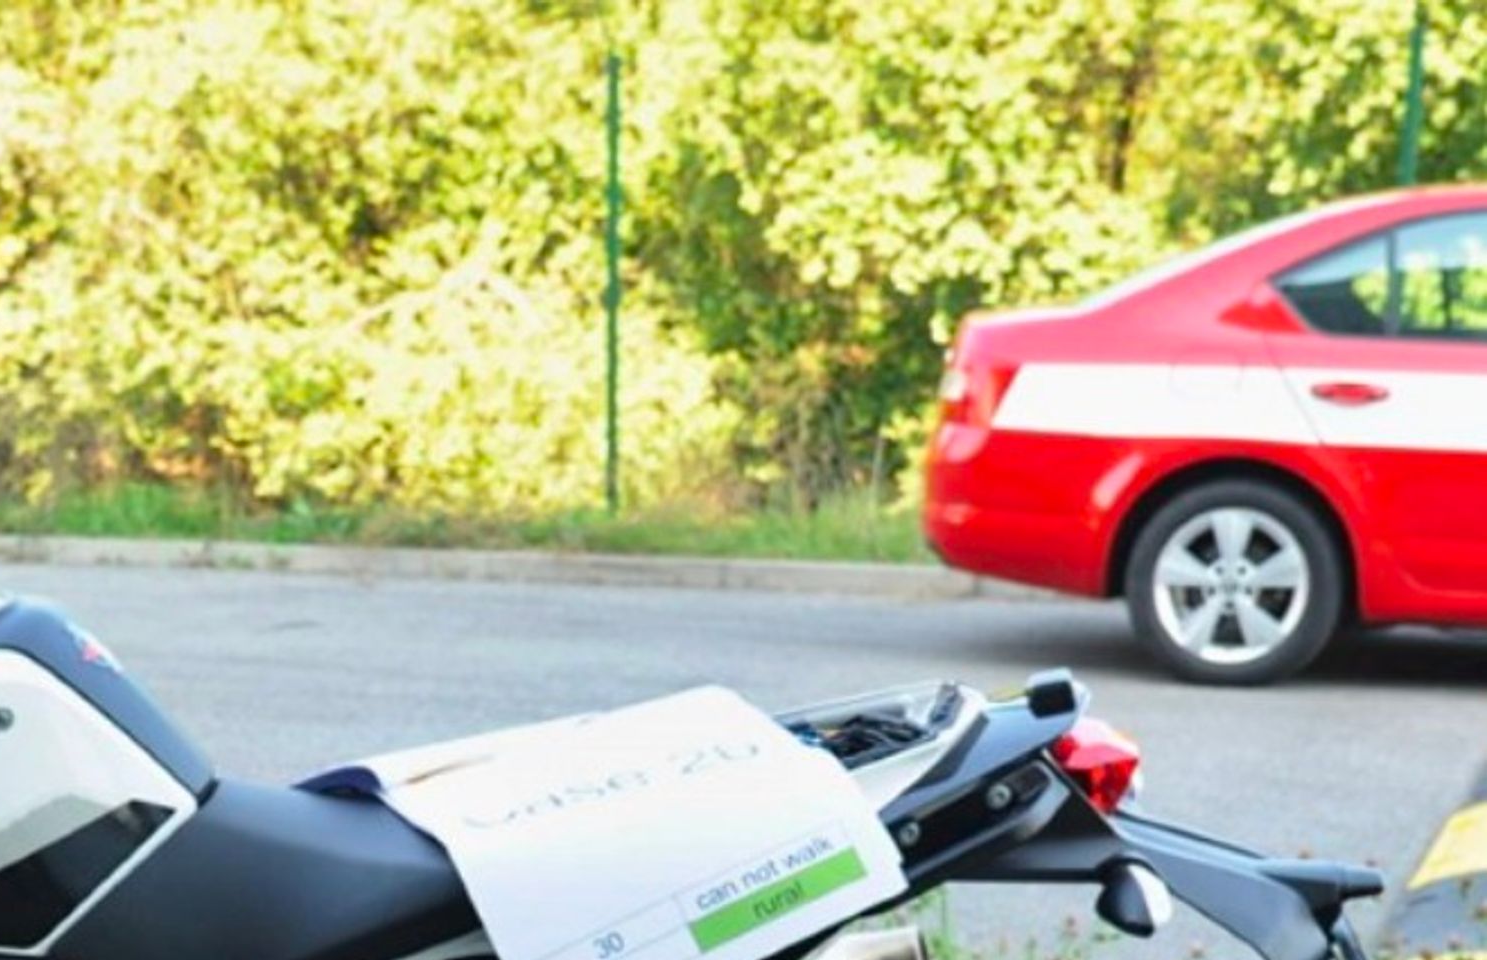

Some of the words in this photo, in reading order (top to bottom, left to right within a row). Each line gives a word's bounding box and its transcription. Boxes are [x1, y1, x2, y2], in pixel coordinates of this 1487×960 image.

[696, 881, 739, 911] can
[741, 860, 780, 888] not
[783, 837, 834, 869] walk
[753, 881, 804, 919] rural
[593, 932, 625, 960] 30
